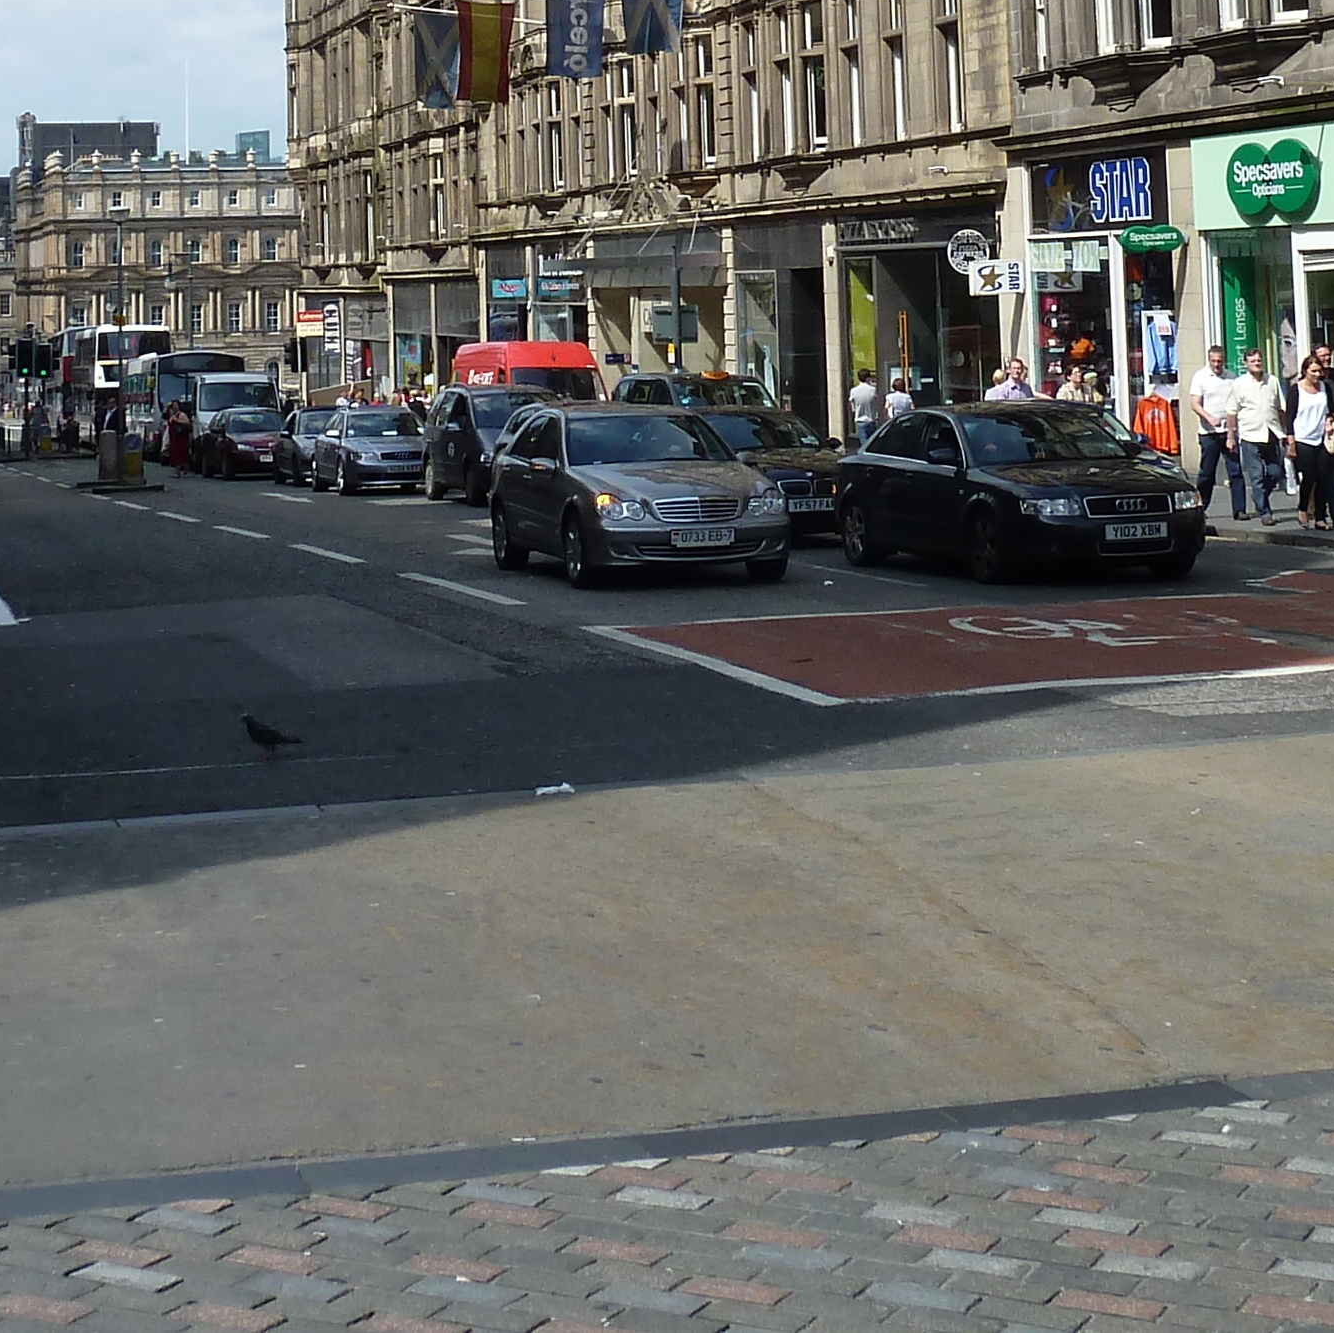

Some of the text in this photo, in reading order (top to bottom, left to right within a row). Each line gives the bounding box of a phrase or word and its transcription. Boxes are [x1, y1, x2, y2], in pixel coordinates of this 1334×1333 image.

[1233, 161, 1304, 187] Specsavers
[1089, 155, 1153, 223] STAR
[1252, 183, 1285, 198] Opticians
[1129, 232, 1178, 242] Specsavers
[1008, 262, 1021, 290] STAR
[323, 303, 341, 353] CULT
[1234, 298, 1246, 340] Lenses
[681, 529, 733, 543] 0733 EB-7
